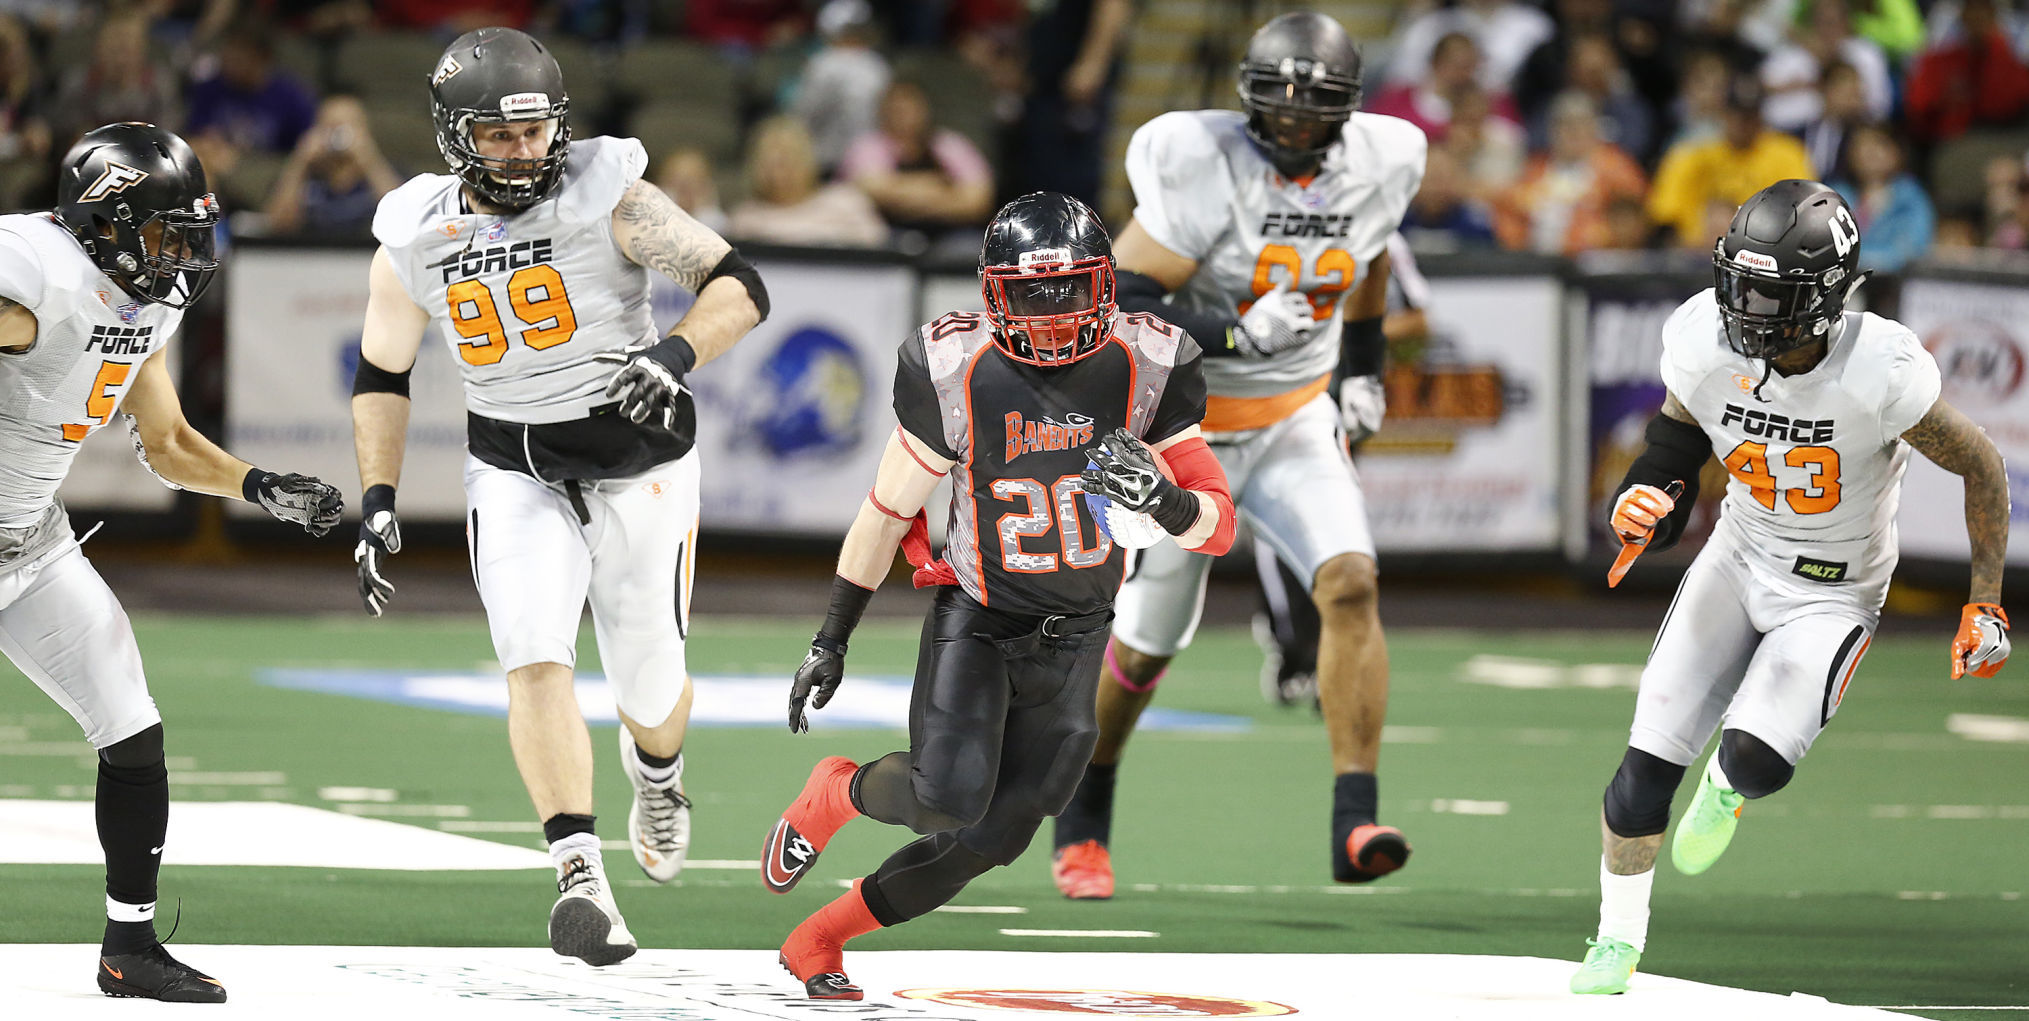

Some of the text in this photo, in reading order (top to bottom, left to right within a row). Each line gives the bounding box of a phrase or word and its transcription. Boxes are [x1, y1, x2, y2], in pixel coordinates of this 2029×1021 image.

[511, 96, 537, 105] Riddell
[1261, 214, 1352, 237] FORCE
[1828, 205, 1859, 258] 43
[443, 238, 552, 284] FORCE
[1031, 252, 1060, 261] Riddell
[1739, 253, 1772, 268] Riddell
[446, 263, 578, 367] 99
[84, 325, 153, 354] FORCE
[61, 360, 132, 442] 5
[1005, 411, 1094, 464] BANDITS
[1721, 403, 1834, 443] FORCE
[1723, 440, 1843, 515] 43
[989, 474, 1112, 574] 20
[1799, 563, 1842, 579] SALTZ
